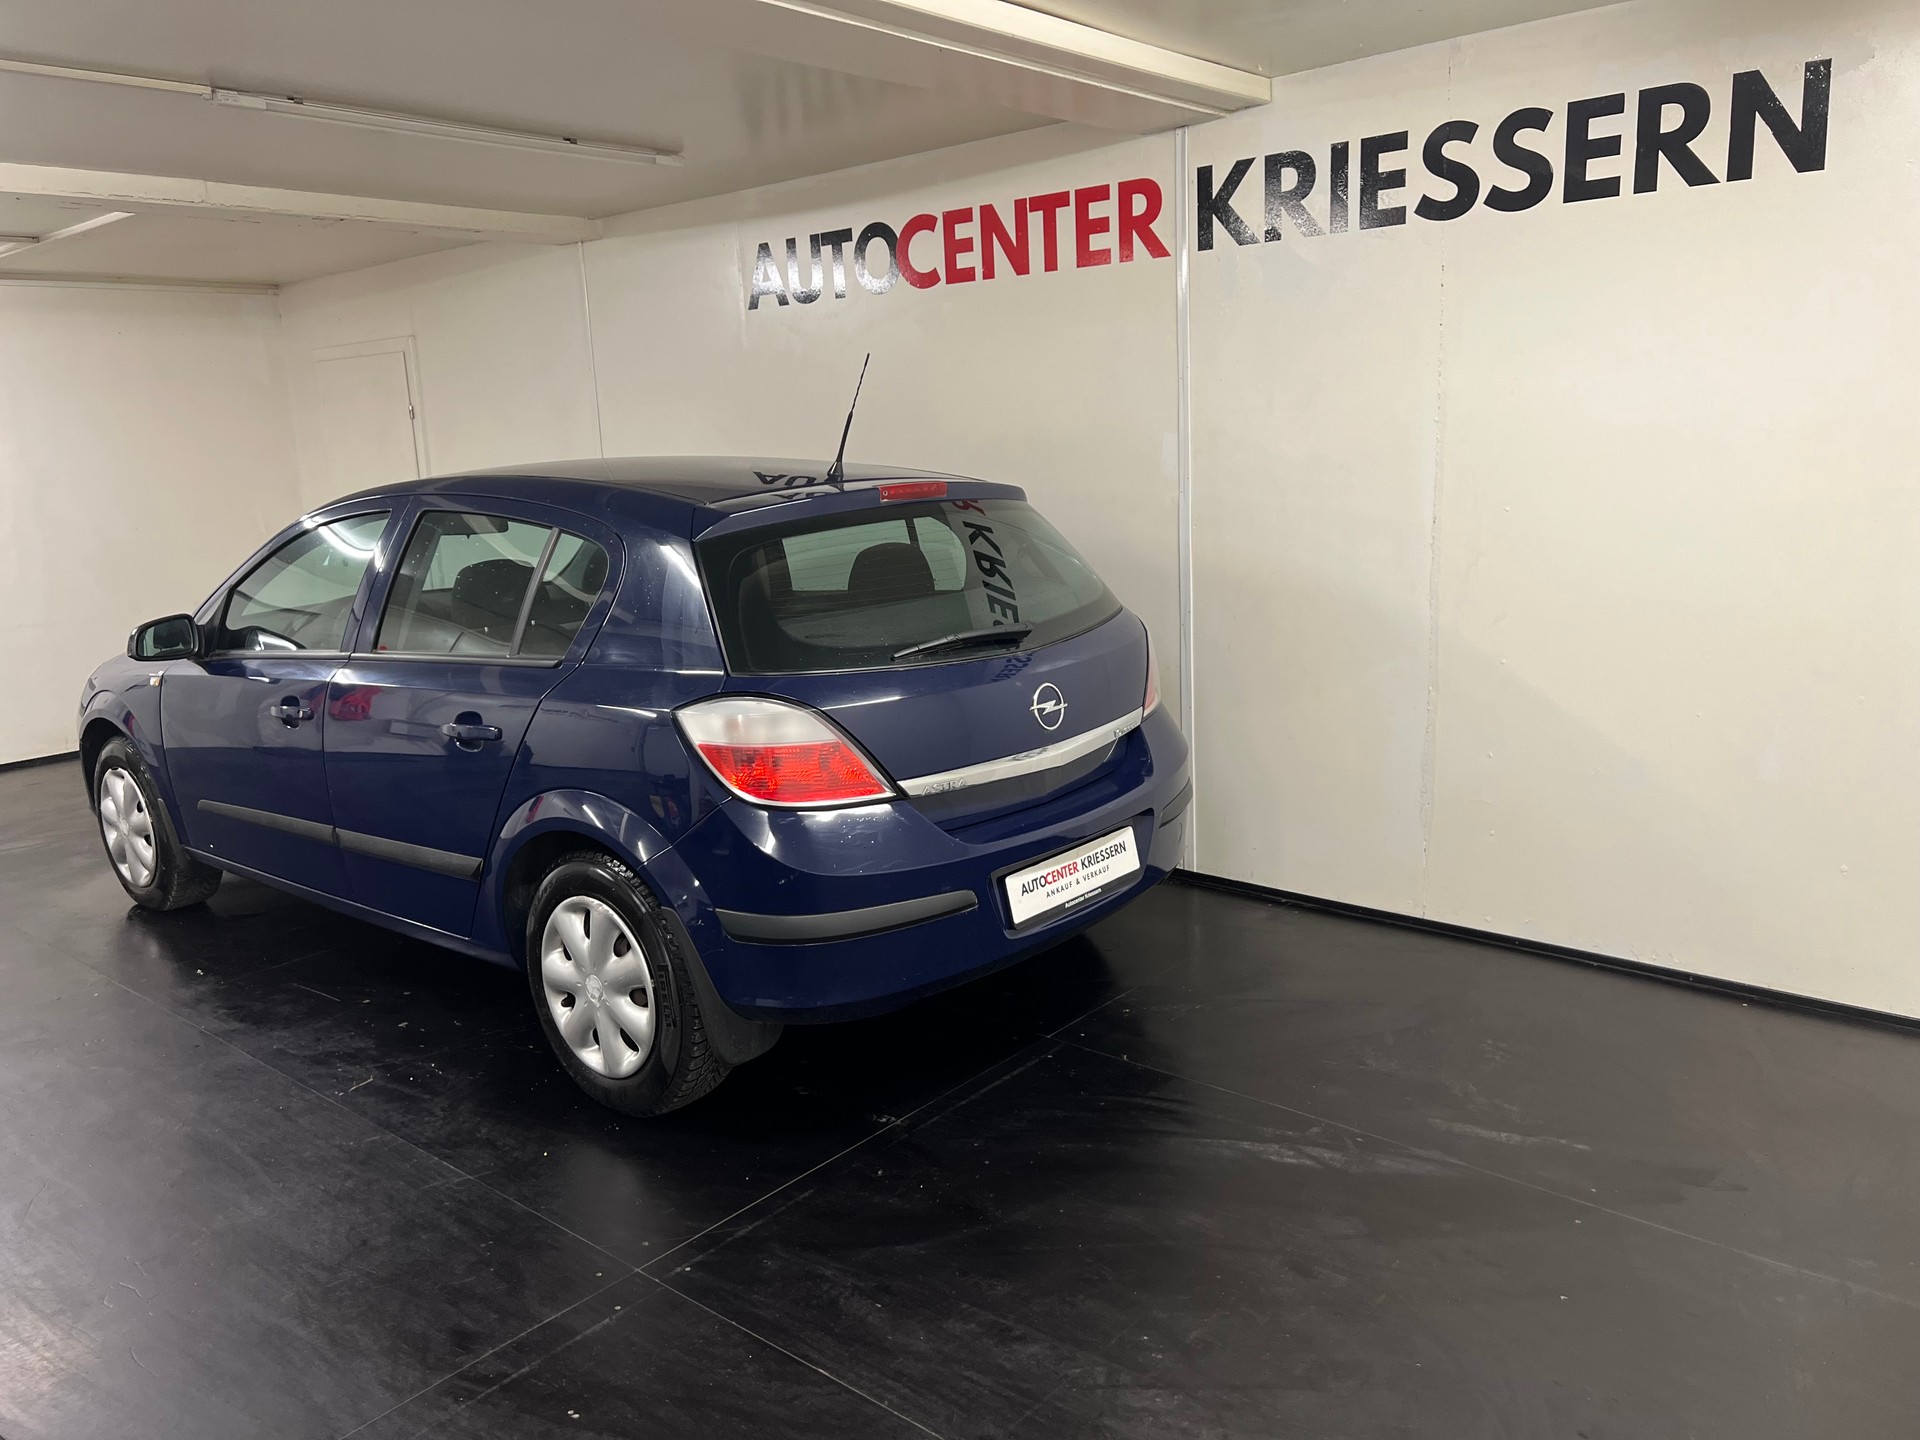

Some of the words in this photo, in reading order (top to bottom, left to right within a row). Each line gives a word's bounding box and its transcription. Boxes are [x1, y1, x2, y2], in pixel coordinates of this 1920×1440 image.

[748, 177, 1171, 310] AUTOCENTER
[1196, 58, 1832, 251] KRIESSERN
[1021, 861, 1080, 896] AUTOCENTER
[1080, 840, 1127, 870] KRIESSERN
[1046, 880, 1073, 898] ANKAUF
[1082, 864, 1110, 882] VERKAUF
